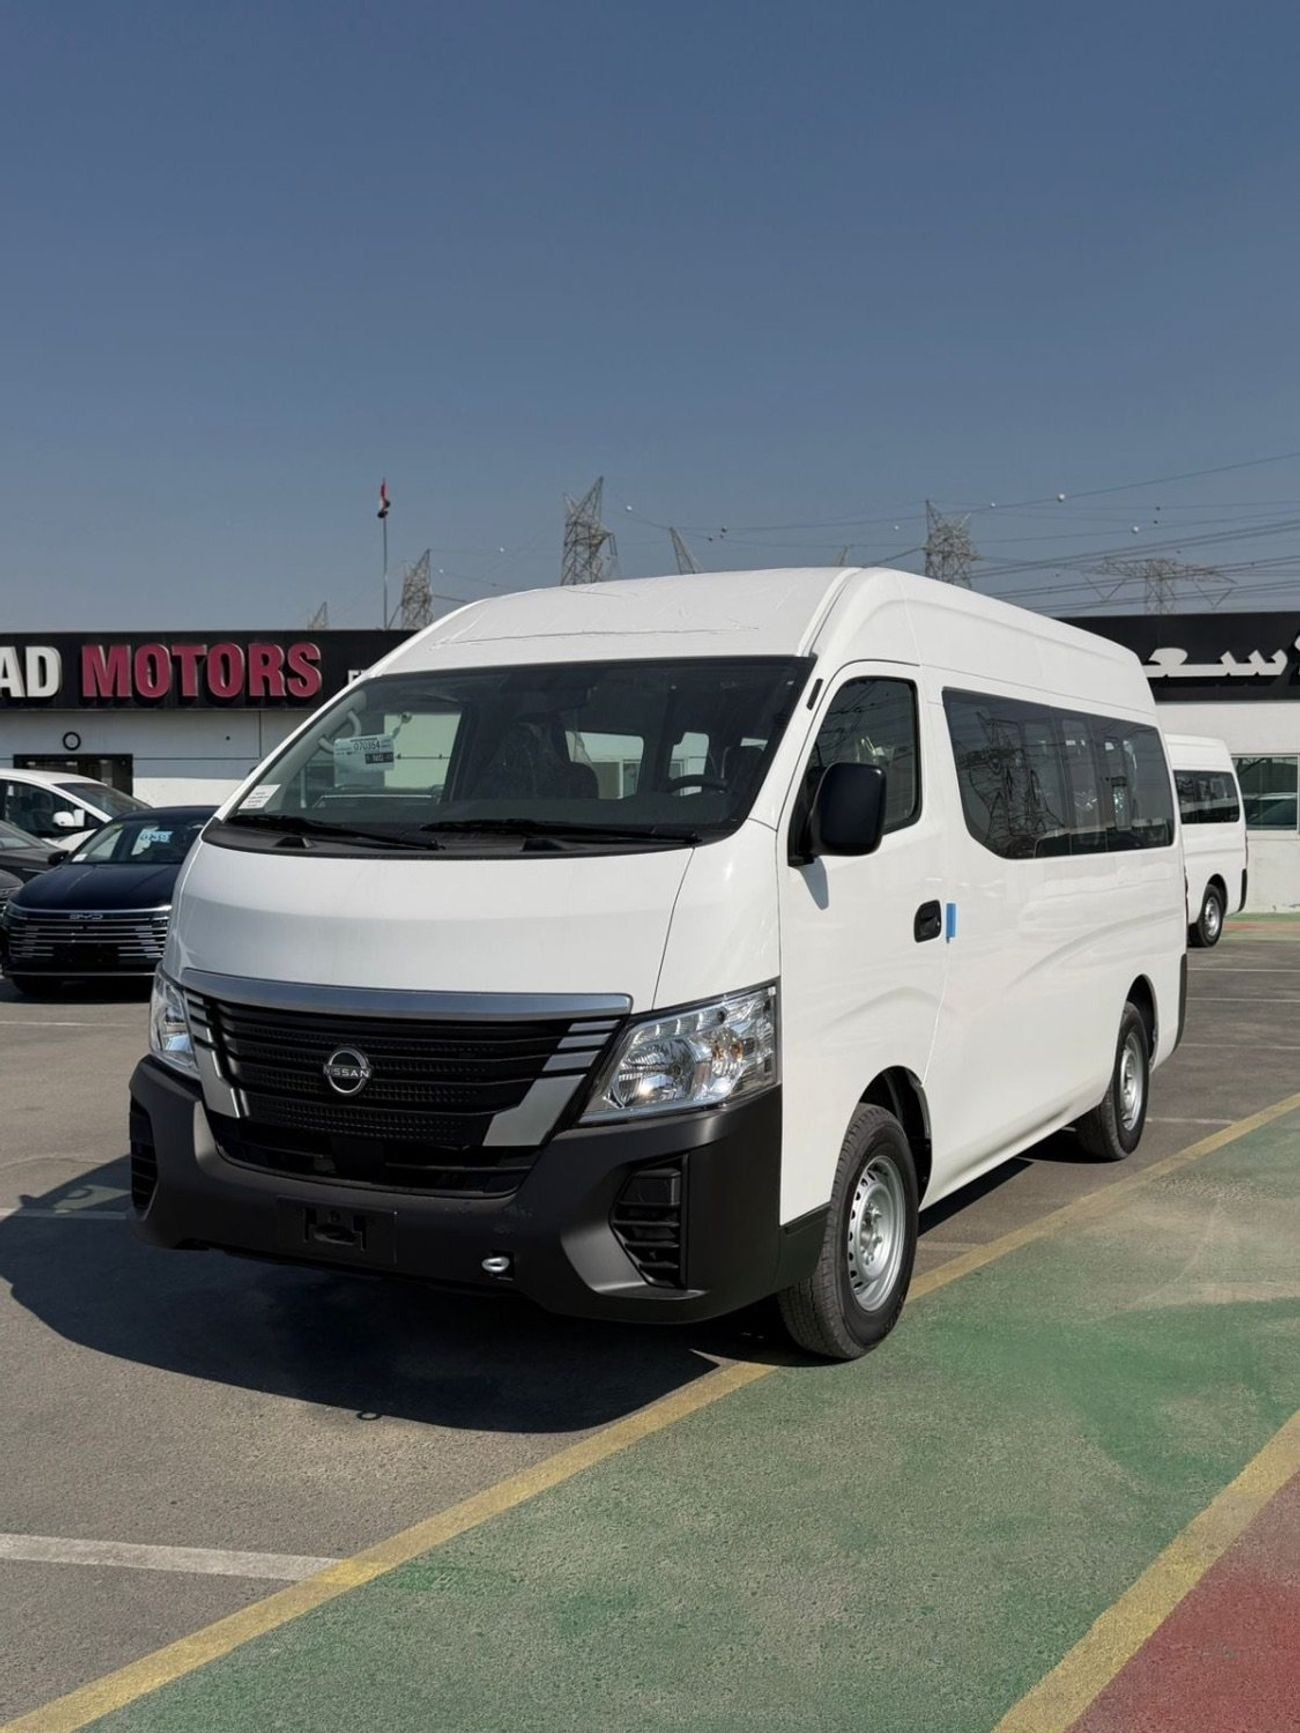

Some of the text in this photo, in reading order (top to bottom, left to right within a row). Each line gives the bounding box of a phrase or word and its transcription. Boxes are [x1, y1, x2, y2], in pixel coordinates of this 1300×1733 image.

[0, 643, 322, 698] AD MOTORS
[323, 1065, 370, 1078] NISSAN
